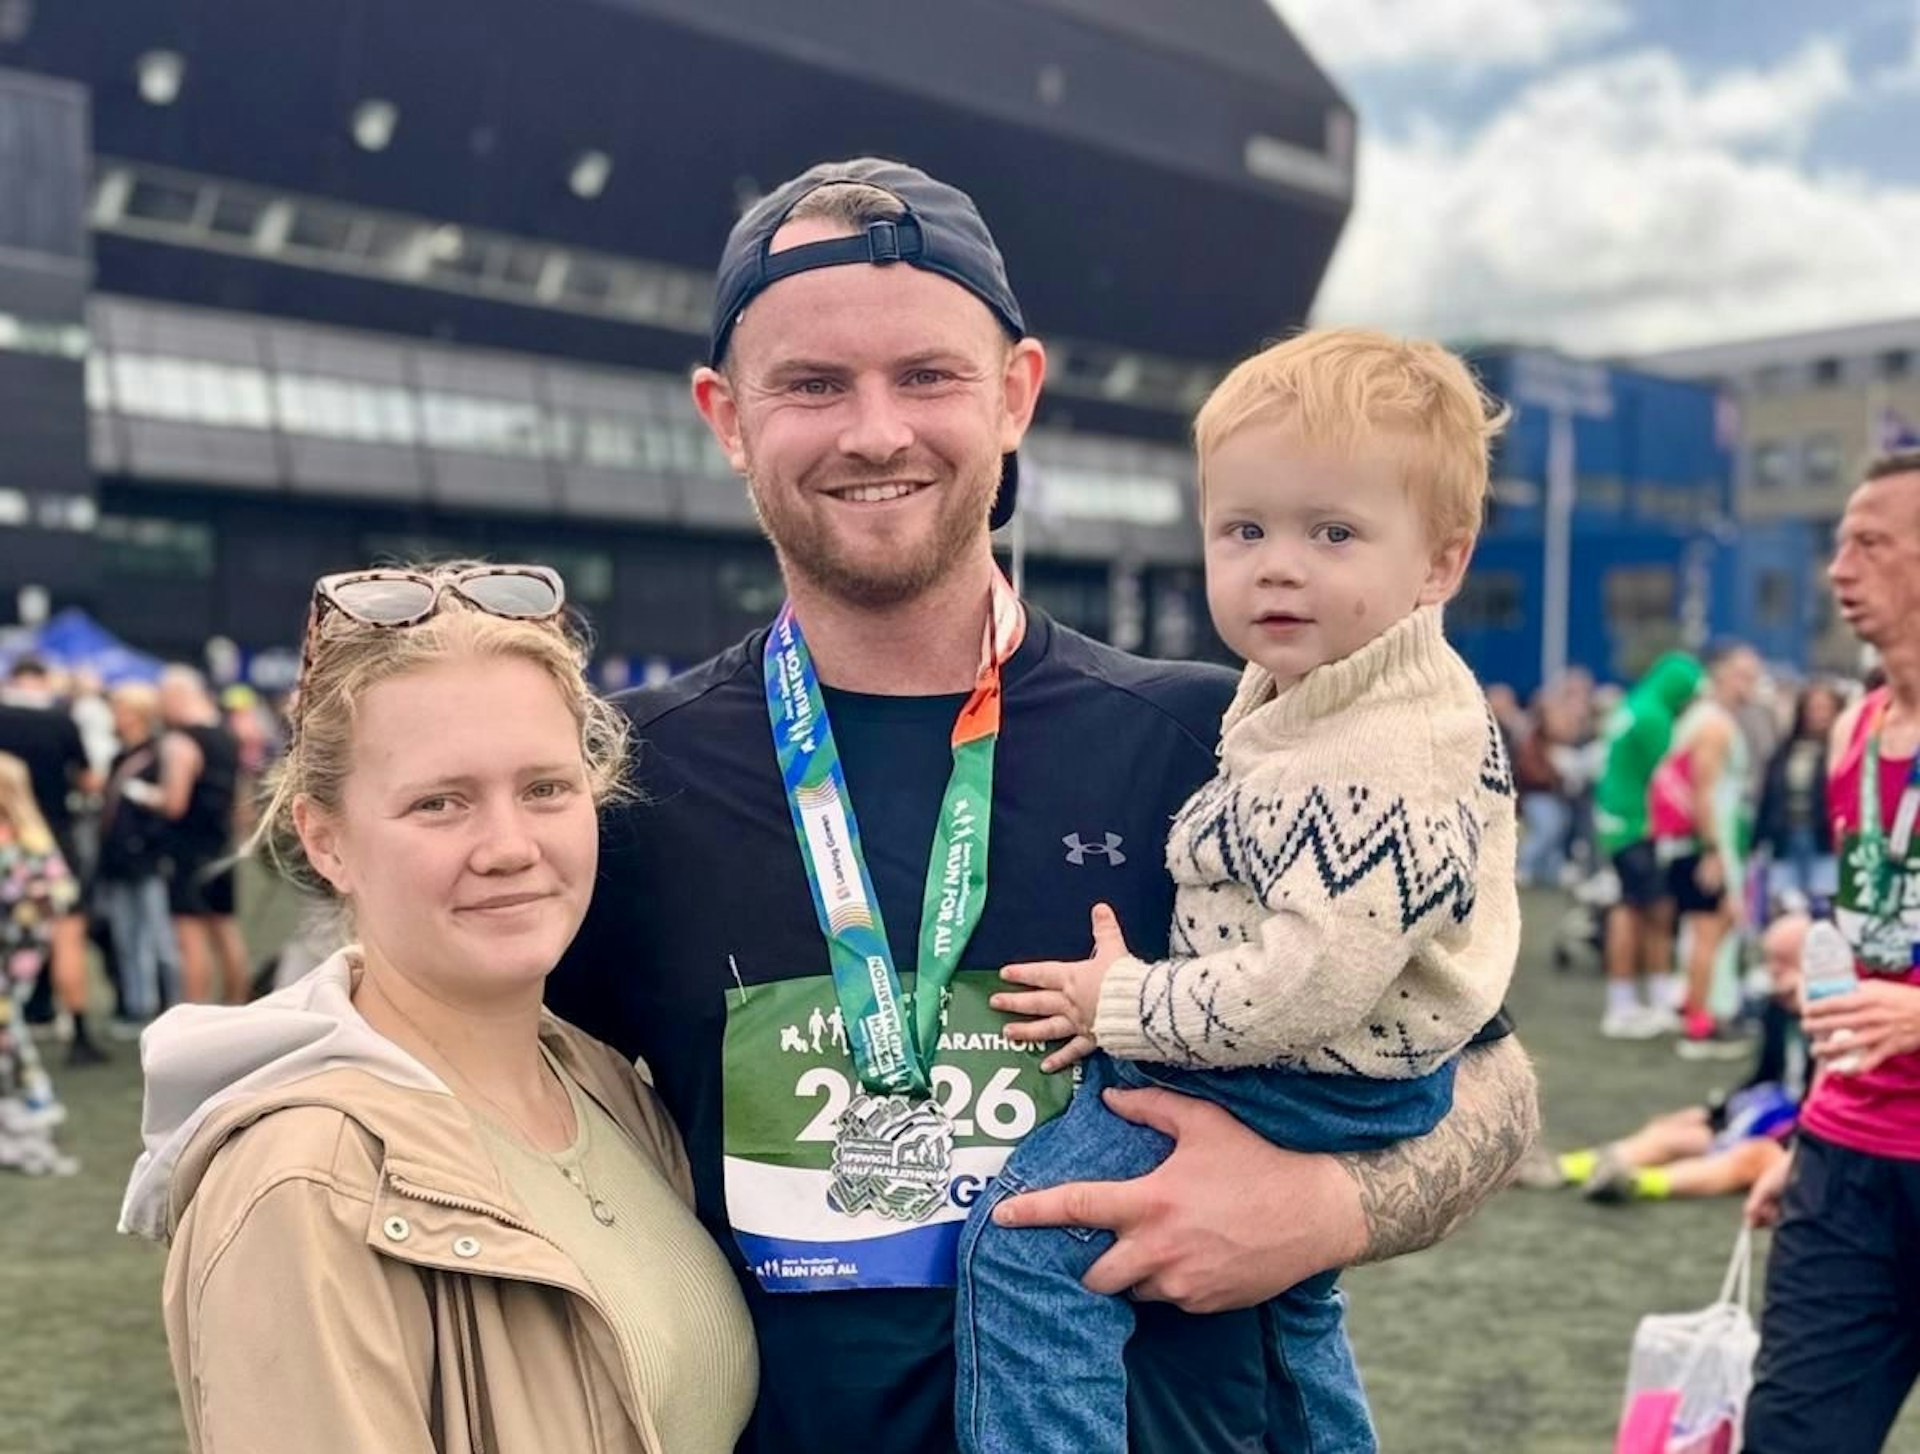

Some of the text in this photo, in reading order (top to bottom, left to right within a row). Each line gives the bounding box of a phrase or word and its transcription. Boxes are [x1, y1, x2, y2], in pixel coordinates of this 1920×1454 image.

[779, 617, 811, 718] RUN FOR ALL
[934, 843, 962, 957] RUN FOR ALL
[871, 957, 898, 1032] MARATHON
[870, 1017, 892, 1072] IPSWICH
[936, 1032, 1046, 1052] ARATHON
[795, 1065, 1036, 1141] 226
[842, 1164, 938, 1182] HALF MARATHON
[782, 1263, 858, 1277] RUN FOR ALL
